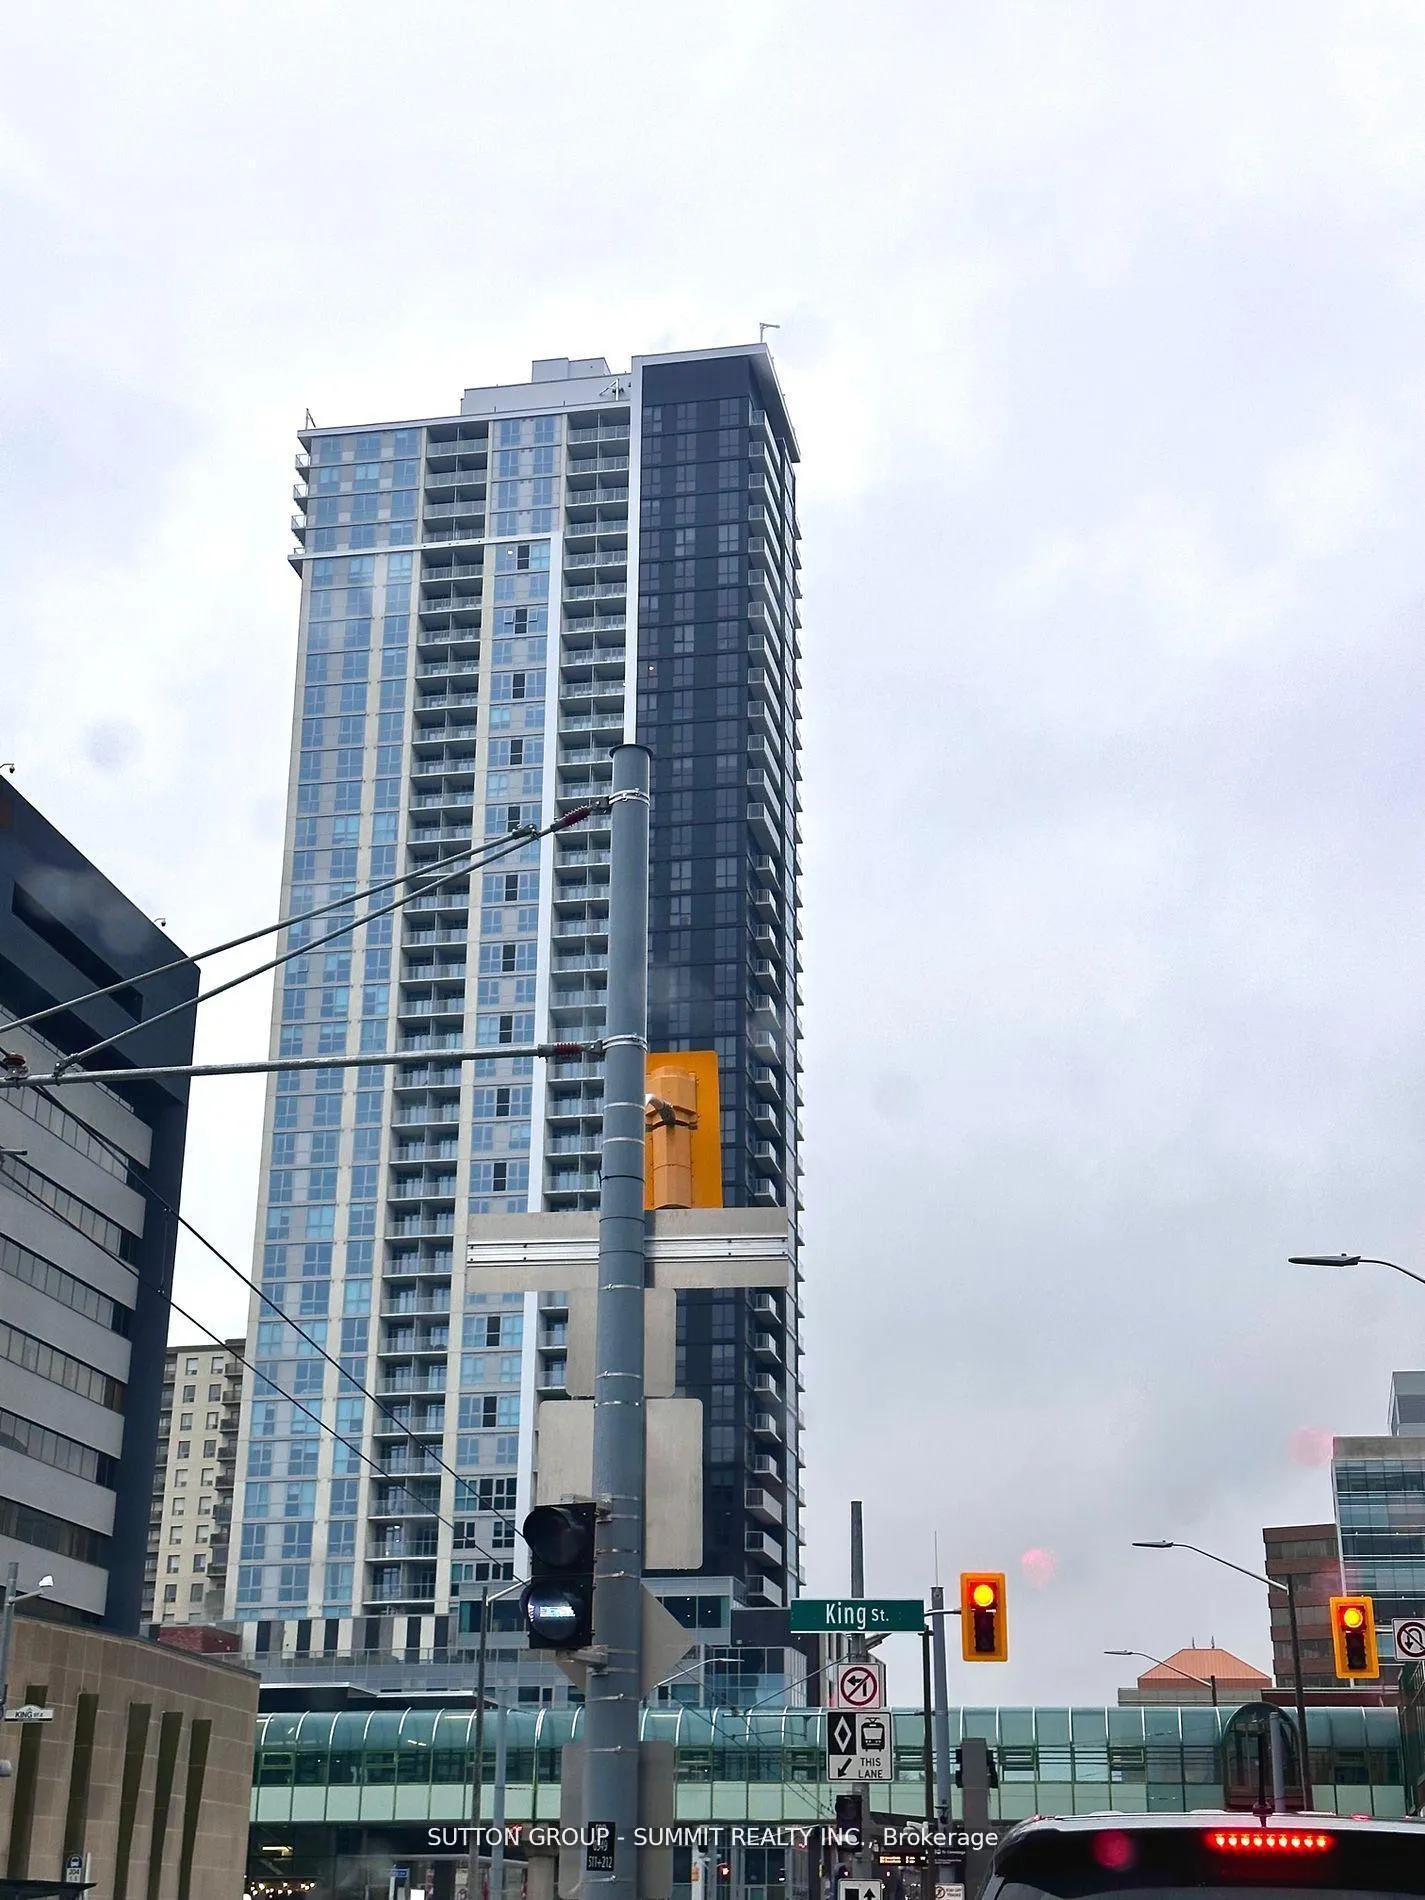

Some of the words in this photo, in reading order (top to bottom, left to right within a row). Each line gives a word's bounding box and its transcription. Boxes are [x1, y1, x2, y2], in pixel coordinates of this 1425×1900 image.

[826, 1602, 866, 1630] King
[871, 1608, 889, 1621] St.
[15, 1711, 33, 1719] KING
[860, 1757, 881, 1767] THIS
[858, 1769, 883, 1779] LANE
